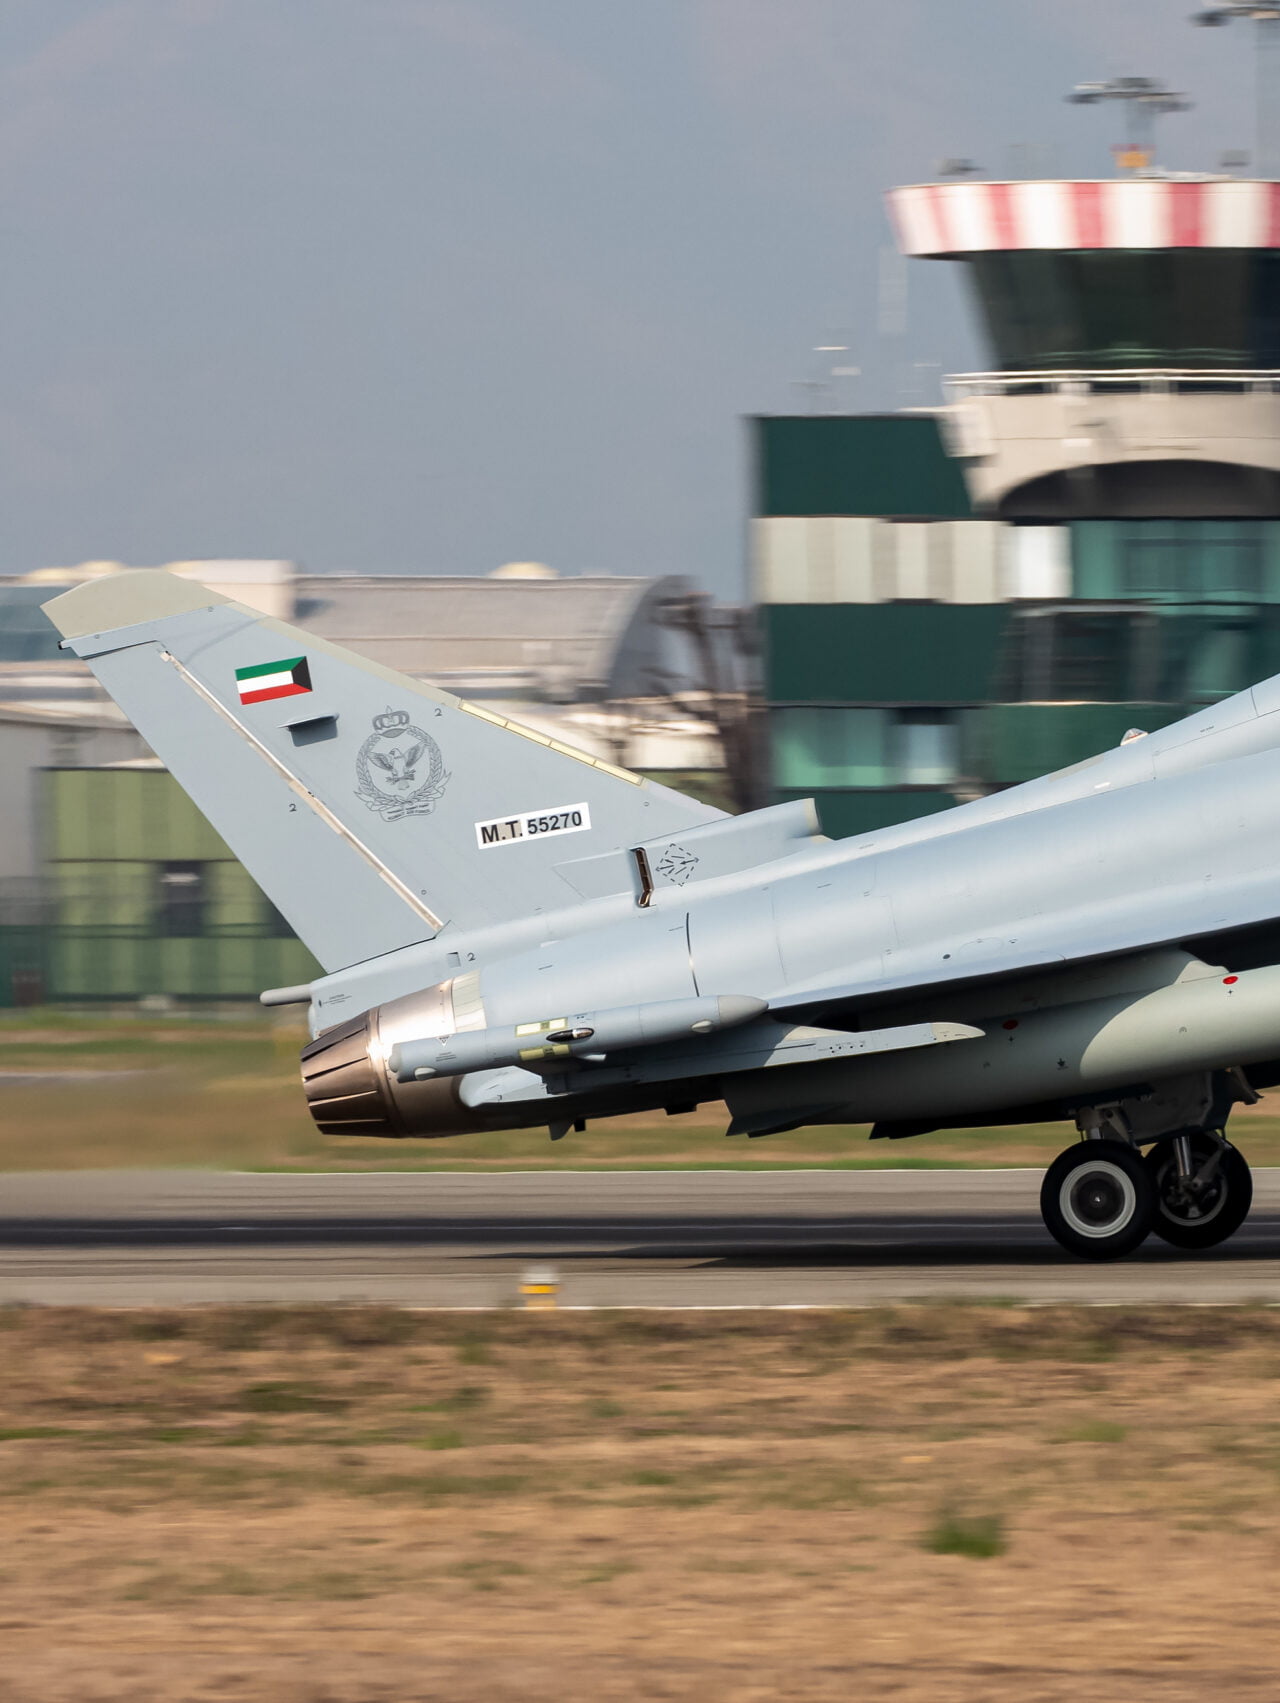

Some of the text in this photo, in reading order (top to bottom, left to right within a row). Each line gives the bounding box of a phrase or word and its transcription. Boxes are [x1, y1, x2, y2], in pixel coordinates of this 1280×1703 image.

[434, 708, 443, 717] 2
[289, 803, 297, 812] 2
[481, 811, 583, 843] M.T. 55270
[468, 952, 476, 962] 2
